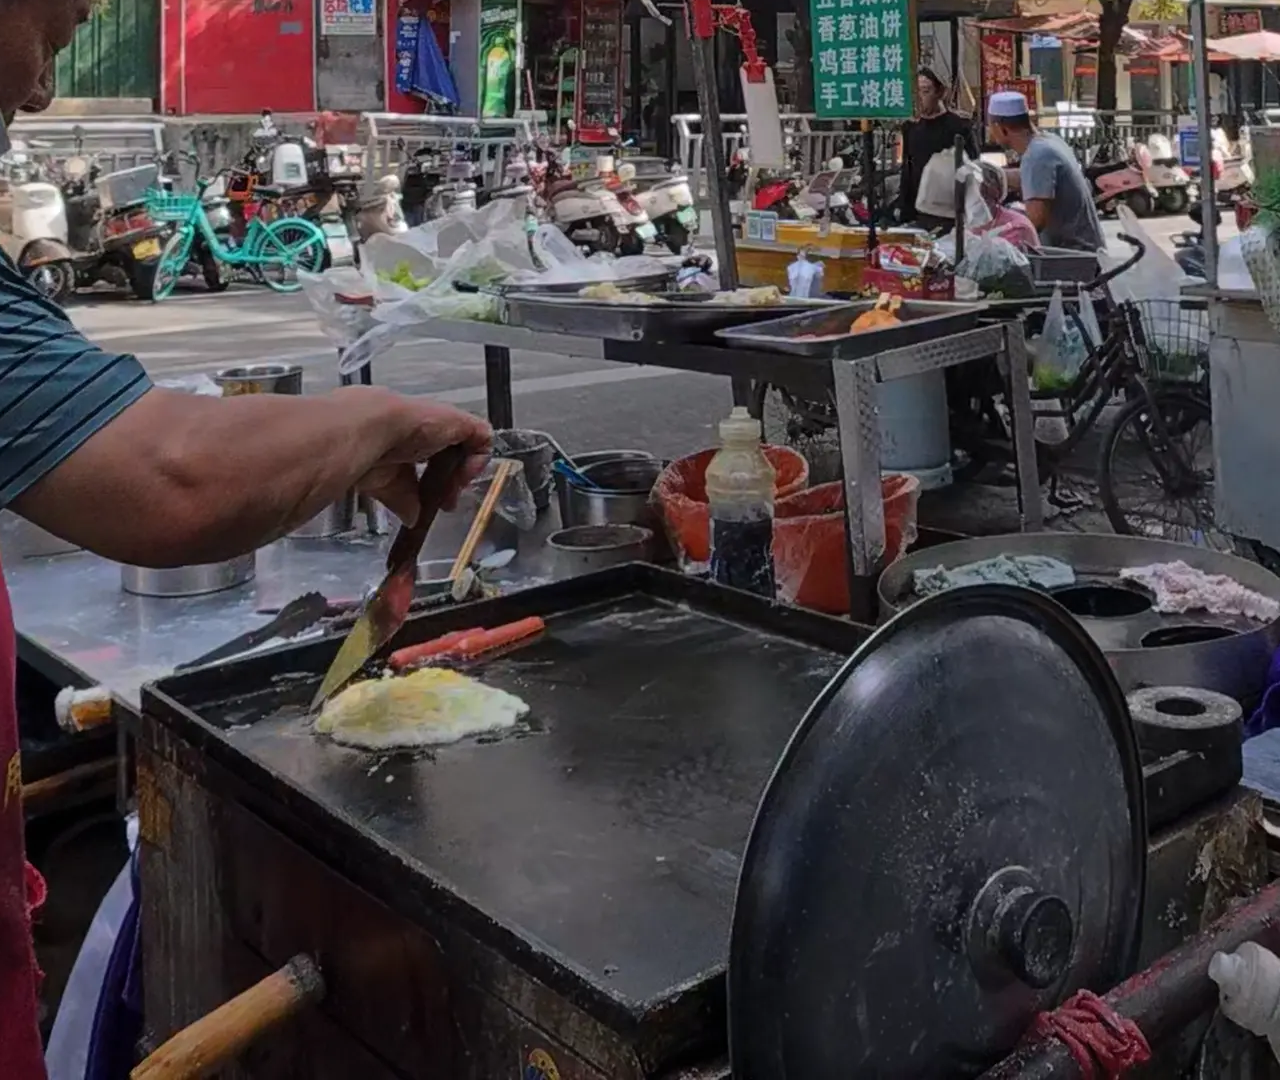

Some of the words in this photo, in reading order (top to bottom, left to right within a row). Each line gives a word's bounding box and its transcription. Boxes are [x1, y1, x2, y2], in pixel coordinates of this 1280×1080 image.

[818, 10, 902, 42] 香葱油饼
[819, 43, 903, 76] 鸡蛋灌饼
[820, 78, 905, 109] 手工烙馍
